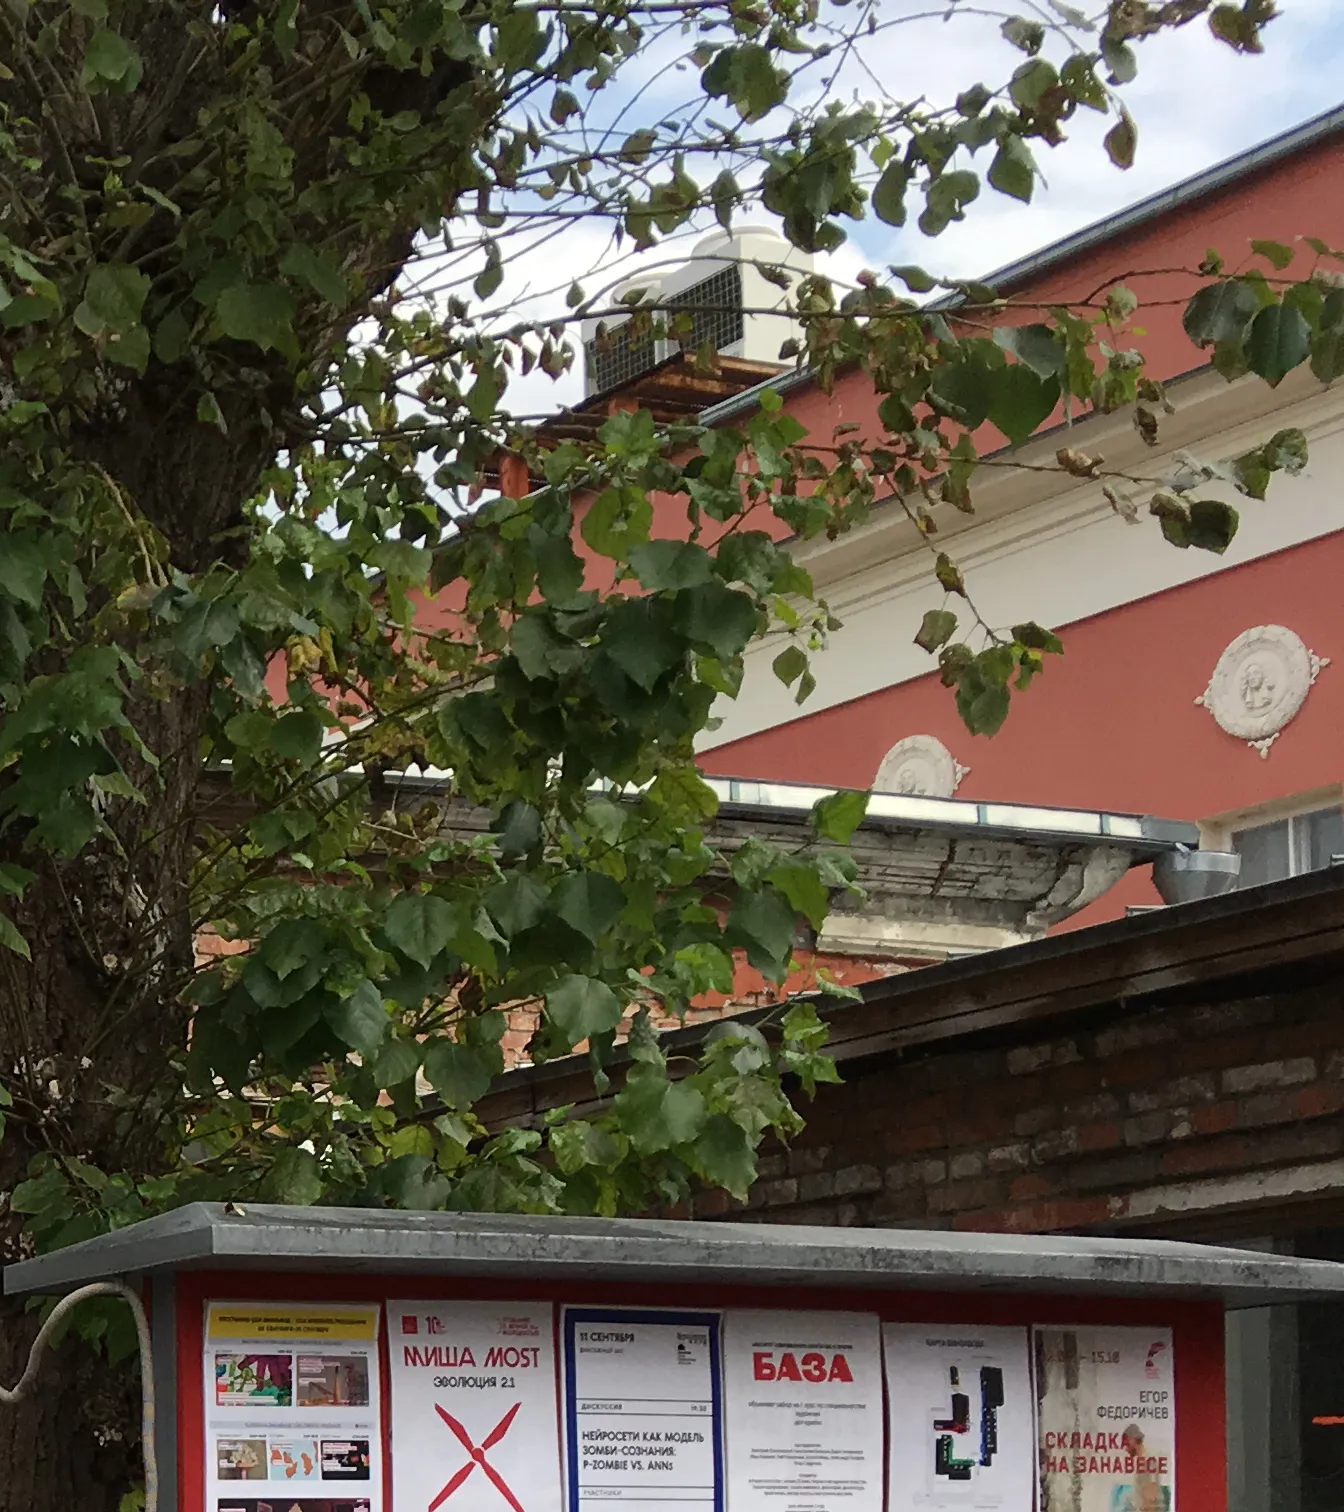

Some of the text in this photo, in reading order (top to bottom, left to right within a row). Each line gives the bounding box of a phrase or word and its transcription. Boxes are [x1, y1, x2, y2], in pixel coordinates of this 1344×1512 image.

[590, 1332, 635, 1342] СЕНТЯБРЯ
[404, 1345, 540, 1368] МИША MOST
[752, 1351, 854, 1383] БАЗА
[433, 1376, 496, 1389] ЭВОЛЮЦИЯ
[1139, 1391, 1168, 1403] ЕГОР
[581, 1403, 622, 1411] ДИСКУССИЯ
[1096, 1405, 1169, 1420] ФЕДОРИЧЕВ
[582, 1429, 705, 1443] НЕЙРОСЕТИ КАК МОДЕЛЬ
[1045, 1431, 1131, 1453] СКЛАДКА
[582, 1445, 677, 1456] ЗОМБИ-СОЗНАНИЯ:
[583, 1460, 628, 1470] P-ZOMBIE
[631, 1460, 645, 1470] VS.
[1046, 1456, 1168, 1474] НА ЗАНАВЕСЕ
